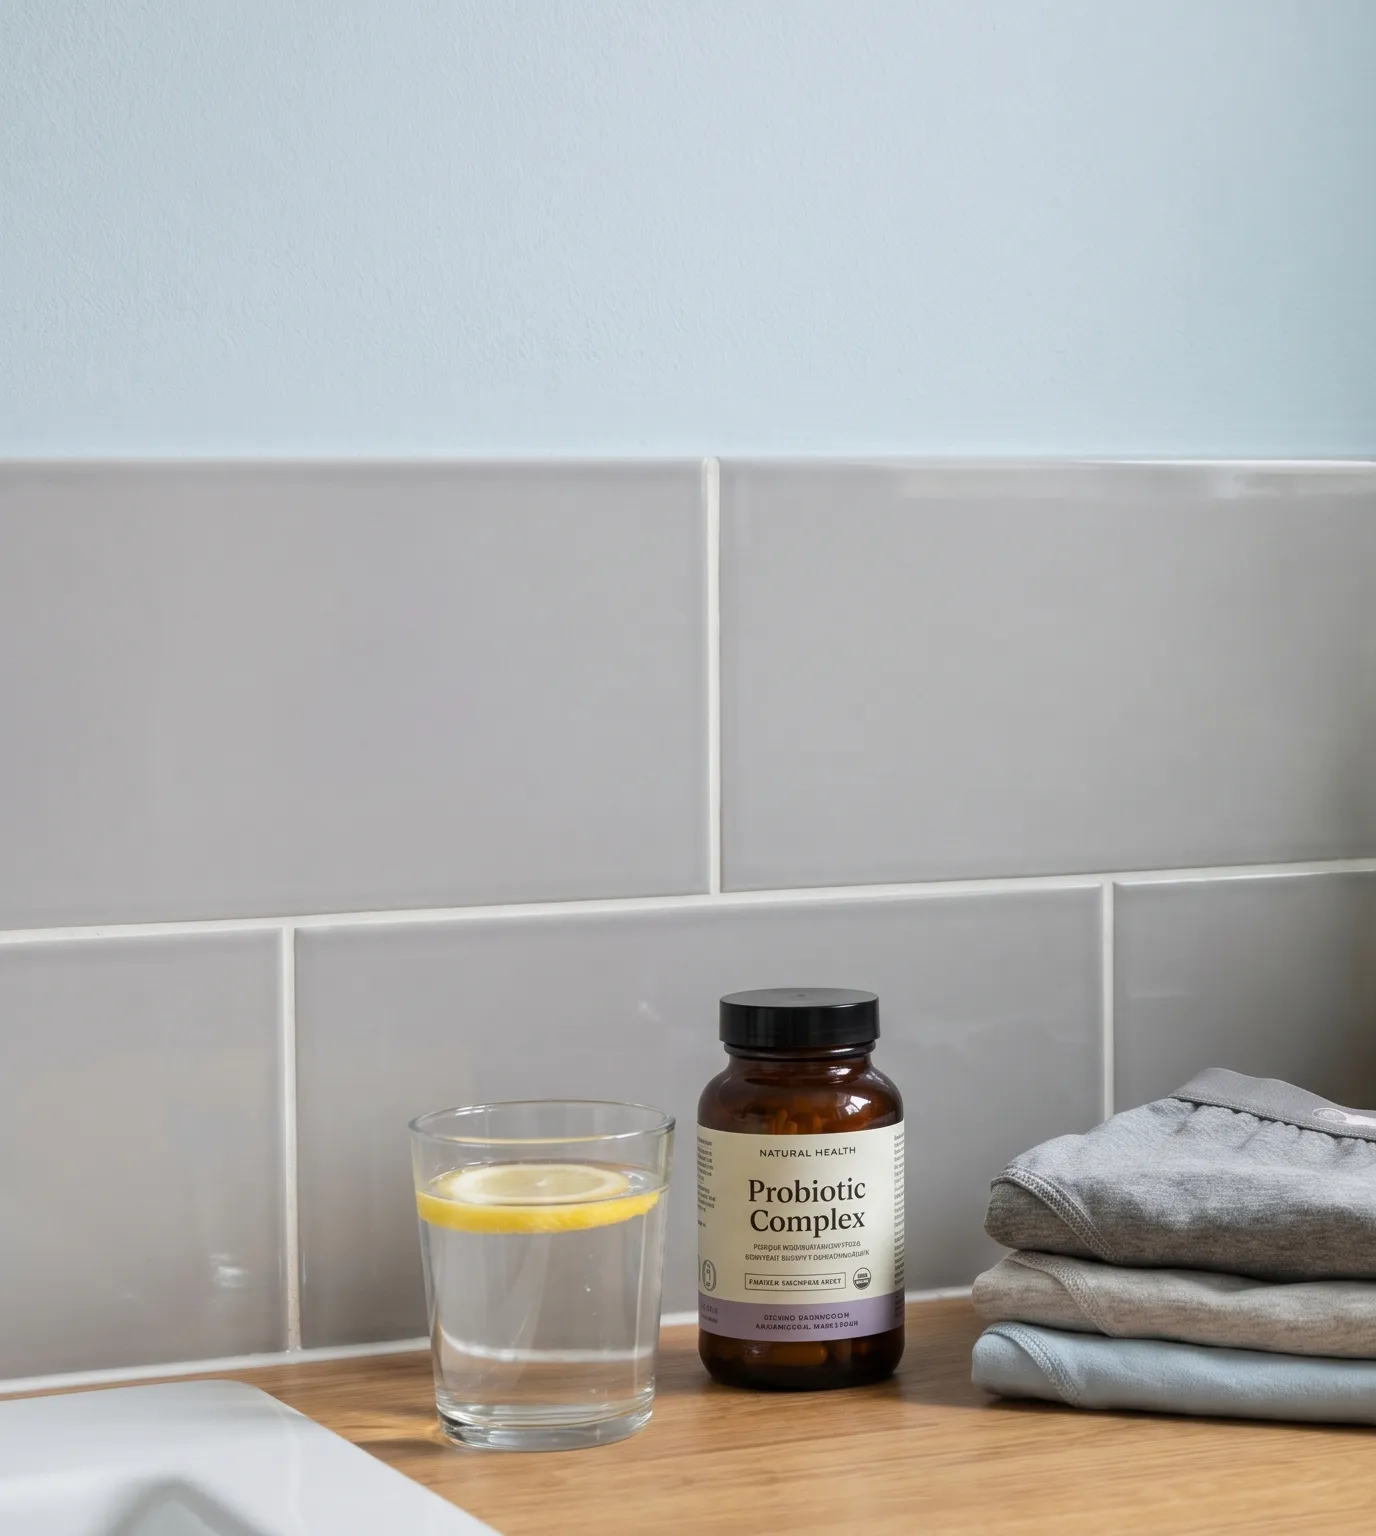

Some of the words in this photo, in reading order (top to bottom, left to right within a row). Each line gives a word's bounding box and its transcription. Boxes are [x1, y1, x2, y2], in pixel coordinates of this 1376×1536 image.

[759, 1150, 812, 1158] NATURAL
[815, 1146, 856, 1157] HEALTH
[749, 1178, 865, 1203] Probiotic
[751, 1208, 865, 1238] Complex
